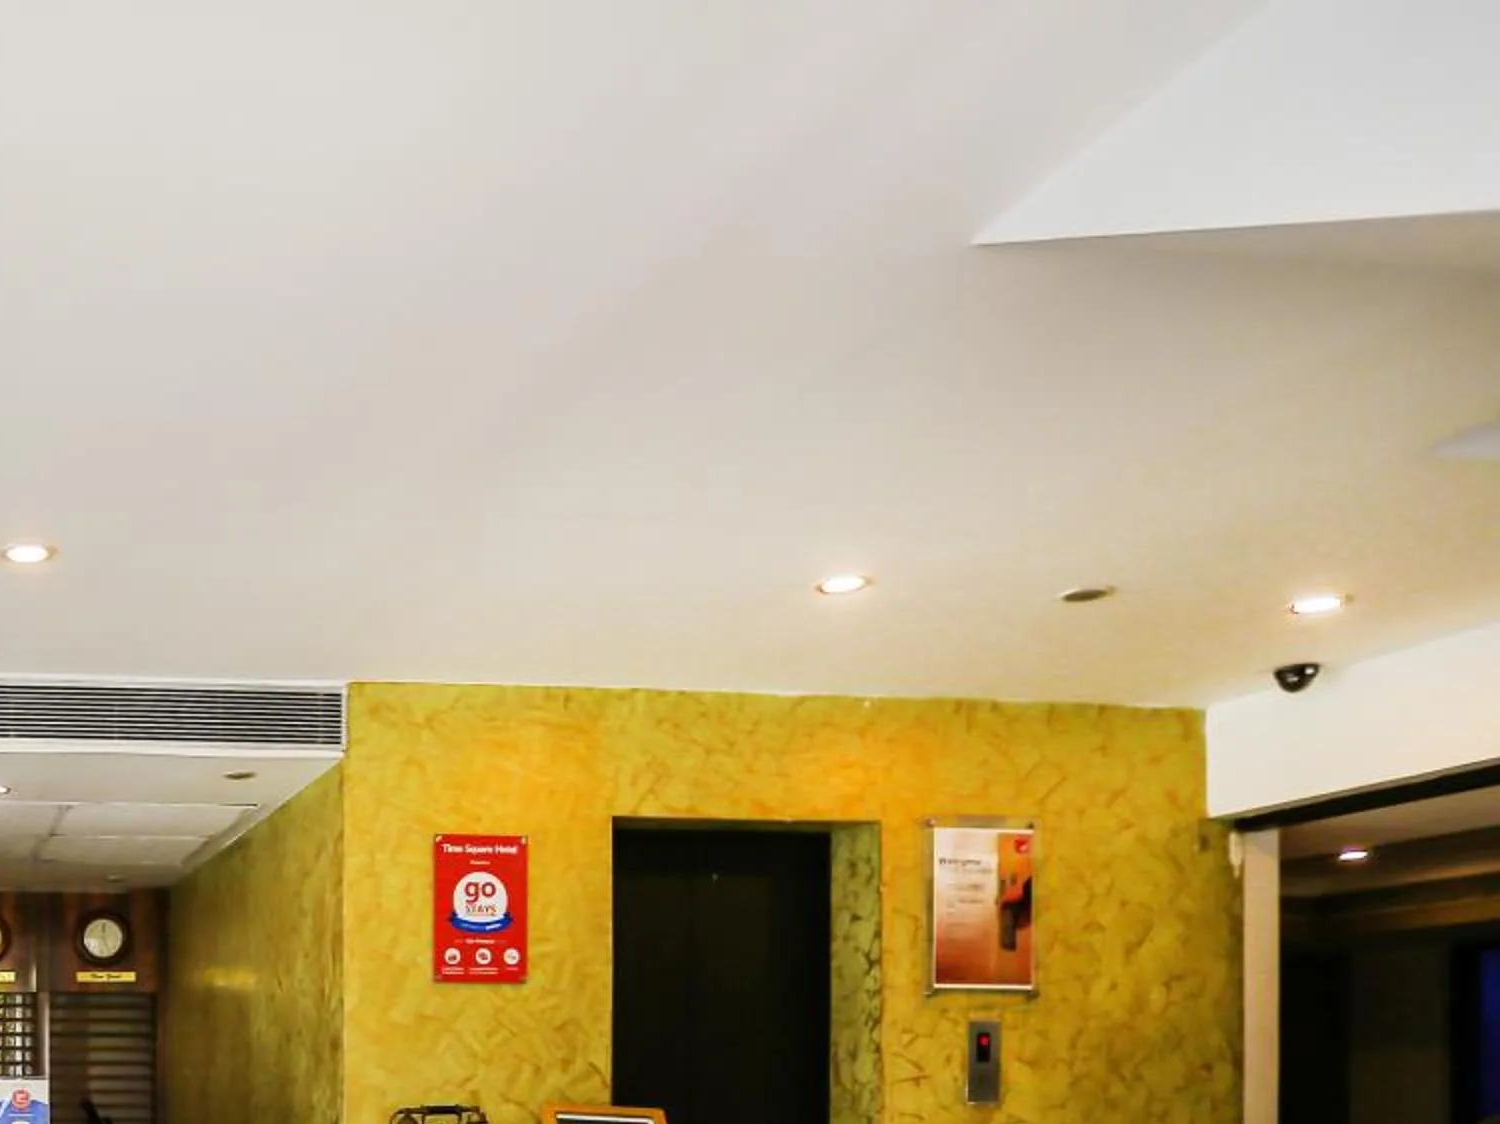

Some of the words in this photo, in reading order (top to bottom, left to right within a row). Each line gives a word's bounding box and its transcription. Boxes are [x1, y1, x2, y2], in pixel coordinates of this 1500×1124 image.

[443, 844, 464, 853] Time
[465, 844, 493, 855] Square
[495, 844, 517, 854] Hotel
[464, 882, 496, 903] go
